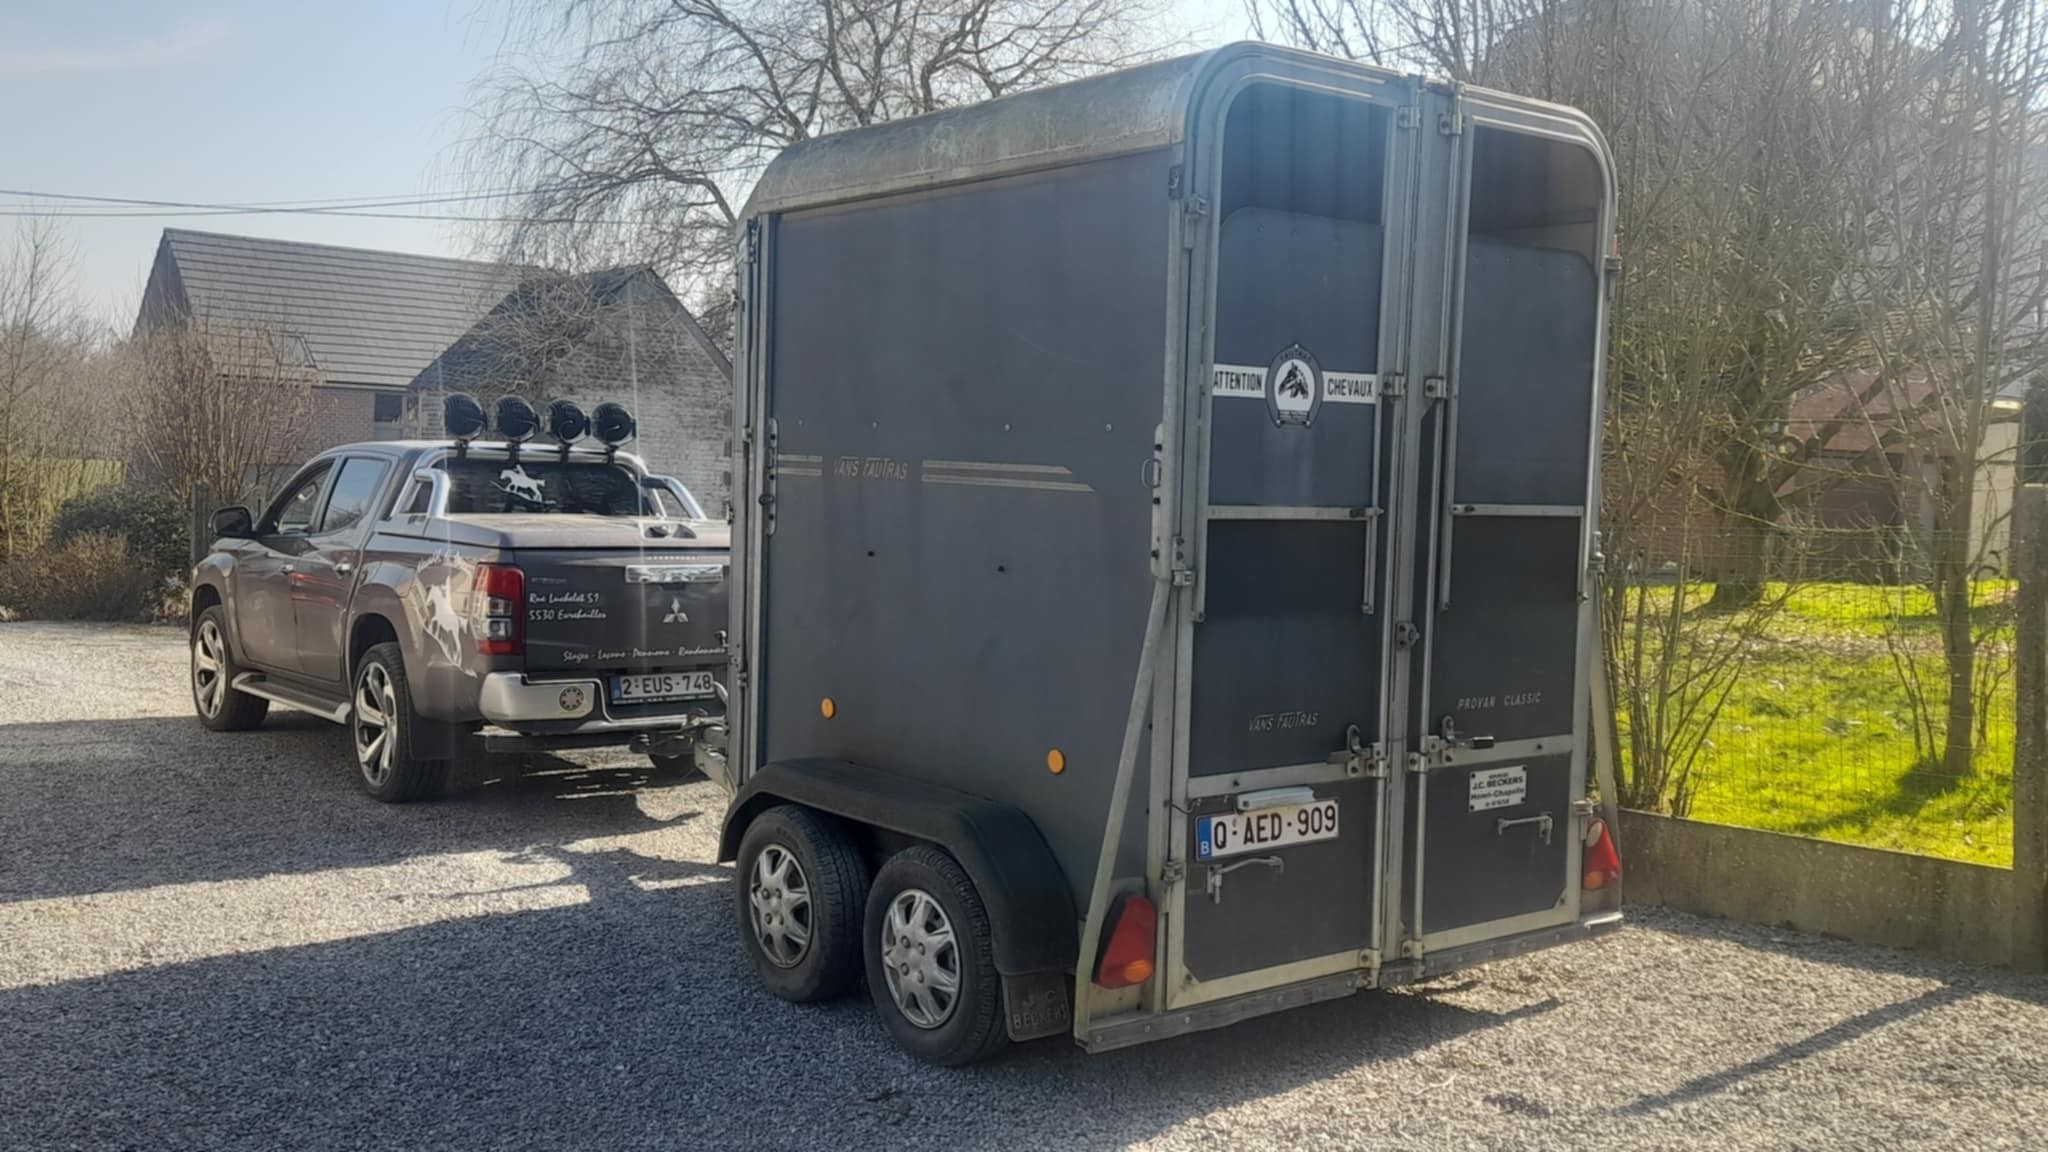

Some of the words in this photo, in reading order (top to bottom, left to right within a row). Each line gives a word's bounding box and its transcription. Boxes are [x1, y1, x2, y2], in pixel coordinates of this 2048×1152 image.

[1214, 370, 1262, 391] ATTENTION
[1327, 378, 1373, 397] CHEVAUX
[529, 593, 545, 603] Rue
[529, 609, 554, 620] 5530
[563, 651, 589, 664] Stages
[1503, 692, 1542, 706] CLASSIC
